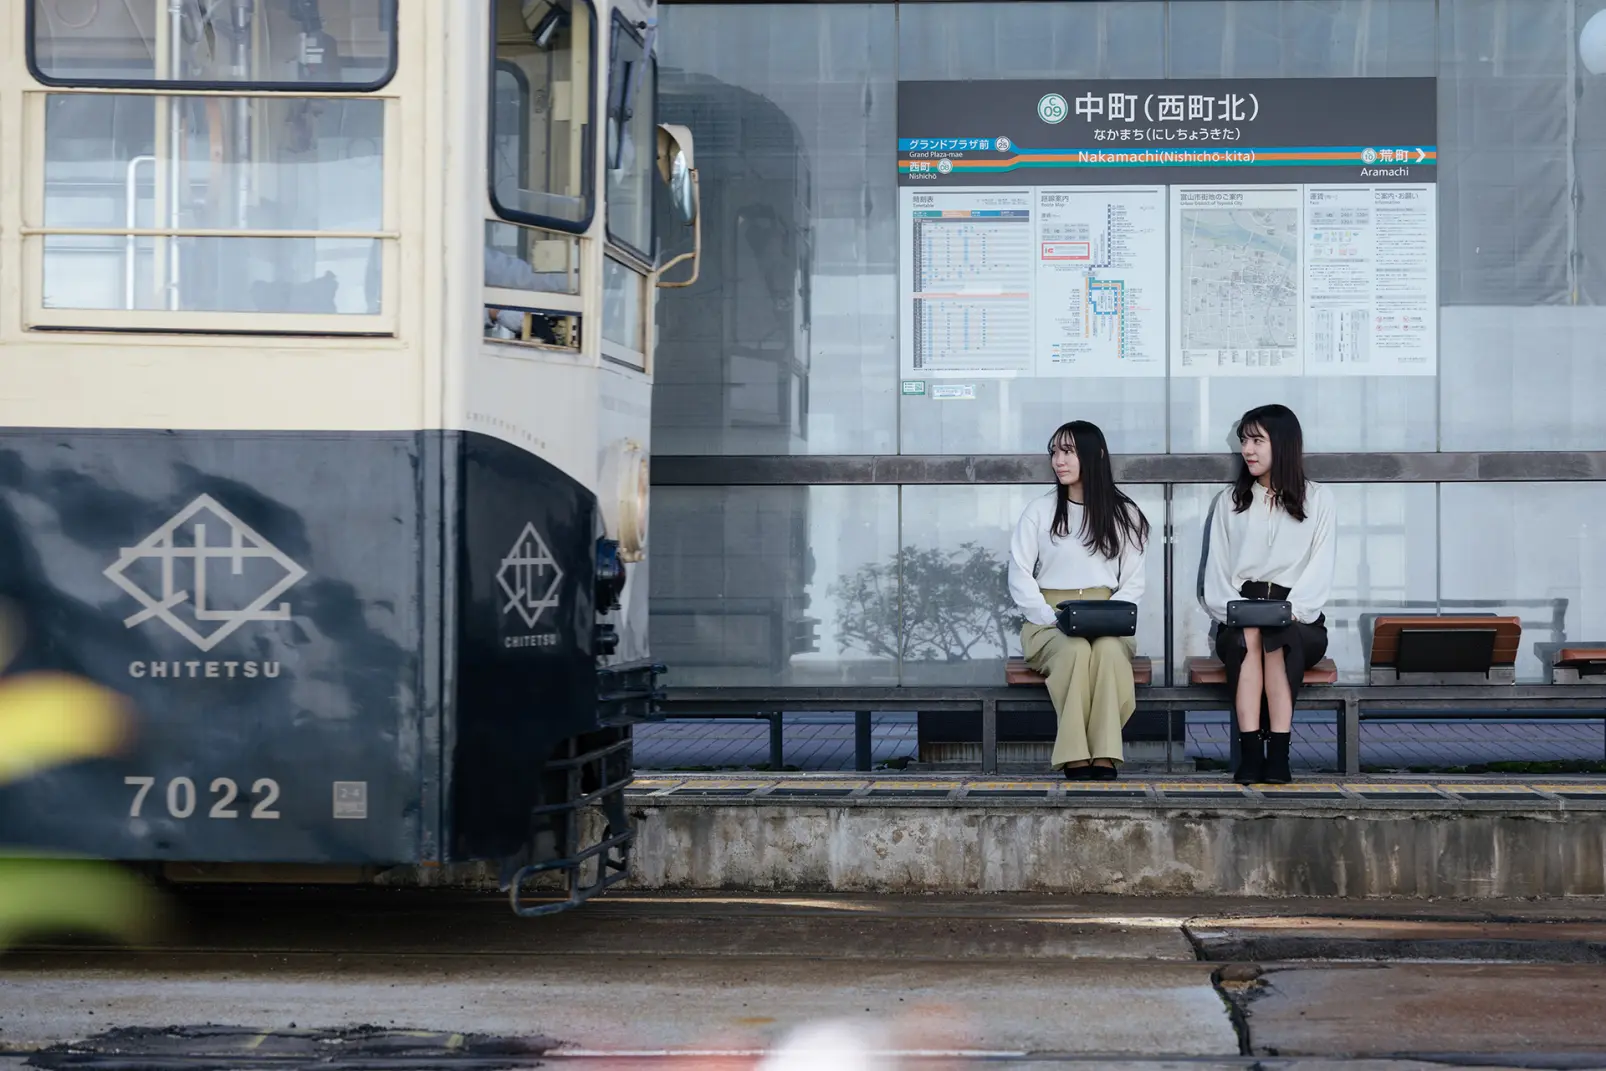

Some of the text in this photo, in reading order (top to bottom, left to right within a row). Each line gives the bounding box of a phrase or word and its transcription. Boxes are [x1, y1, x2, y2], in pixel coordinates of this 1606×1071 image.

[1048, 97, 1056, 106] C
[1043, 106, 1062, 117] 09
[909, 139, 990, 150] グランドプラザ前
[930, 151, 963, 159] Plaza-mae
[1379, 149, 1410, 163] 荒町
[909, 162, 930, 171] 西町
[1360, 167, 1409, 177] Aramachi
[505, 633, 557, 648] CHITETSU
[129, 660, 281, 679] CHITETSU
[123, 775, 281, 819] 7022
